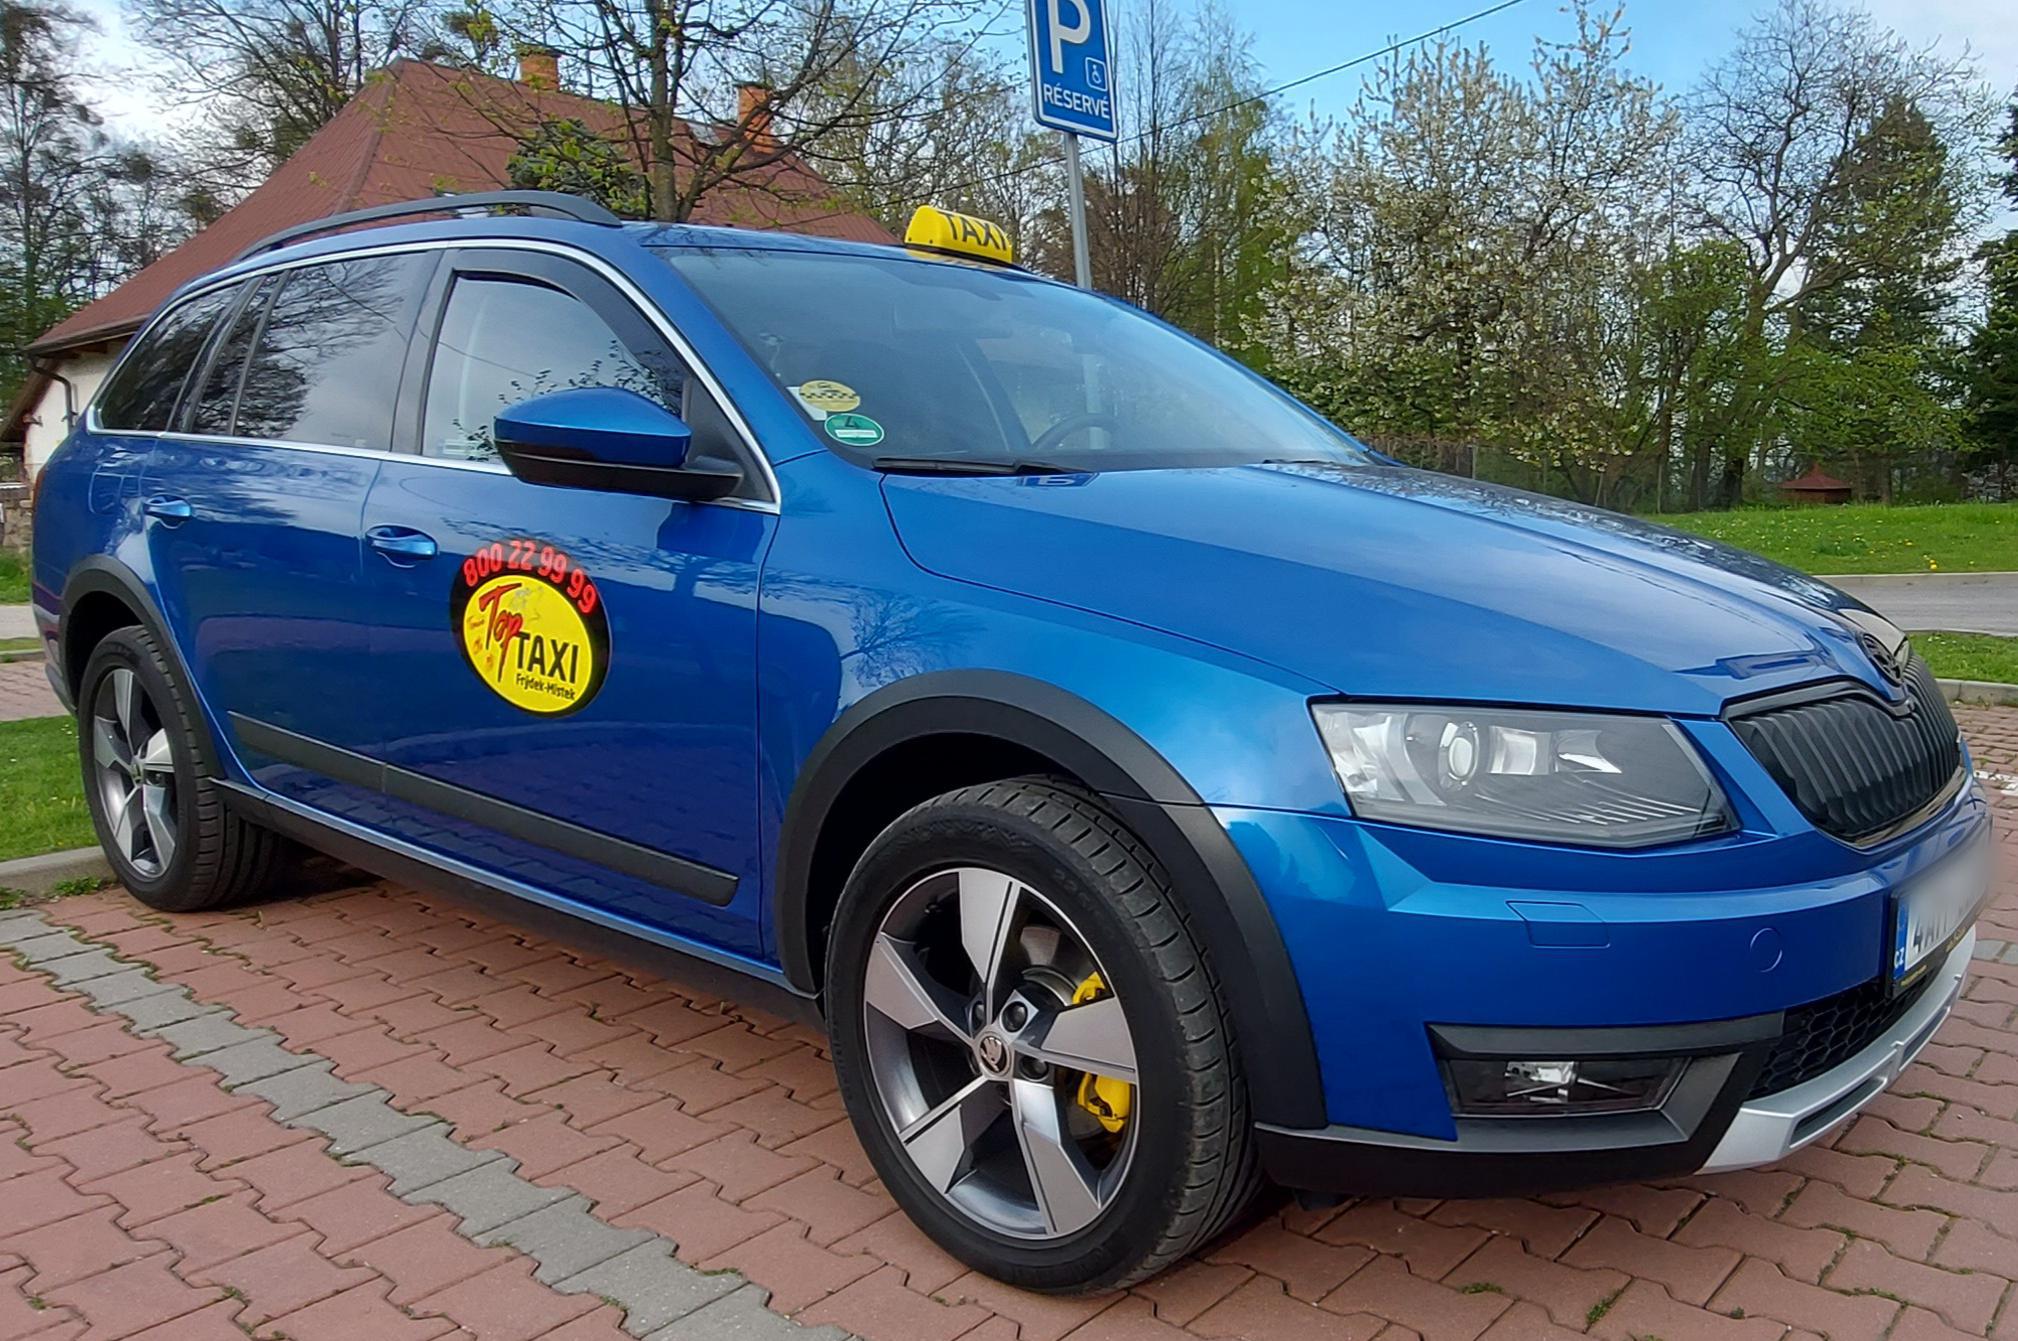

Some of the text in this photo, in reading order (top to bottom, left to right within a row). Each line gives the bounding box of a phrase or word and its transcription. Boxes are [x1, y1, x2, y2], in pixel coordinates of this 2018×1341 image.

[1047, 0, 1091, 74] P
[1043, 82, 1110, 119] RÉSERVÉ
[941, 211, 1008, 251] TAXI
[463, 540, 598, 614] 800 22 99 99
[478, 582, 524, 683] Top
[517, 631, 579, 684] TAXI
